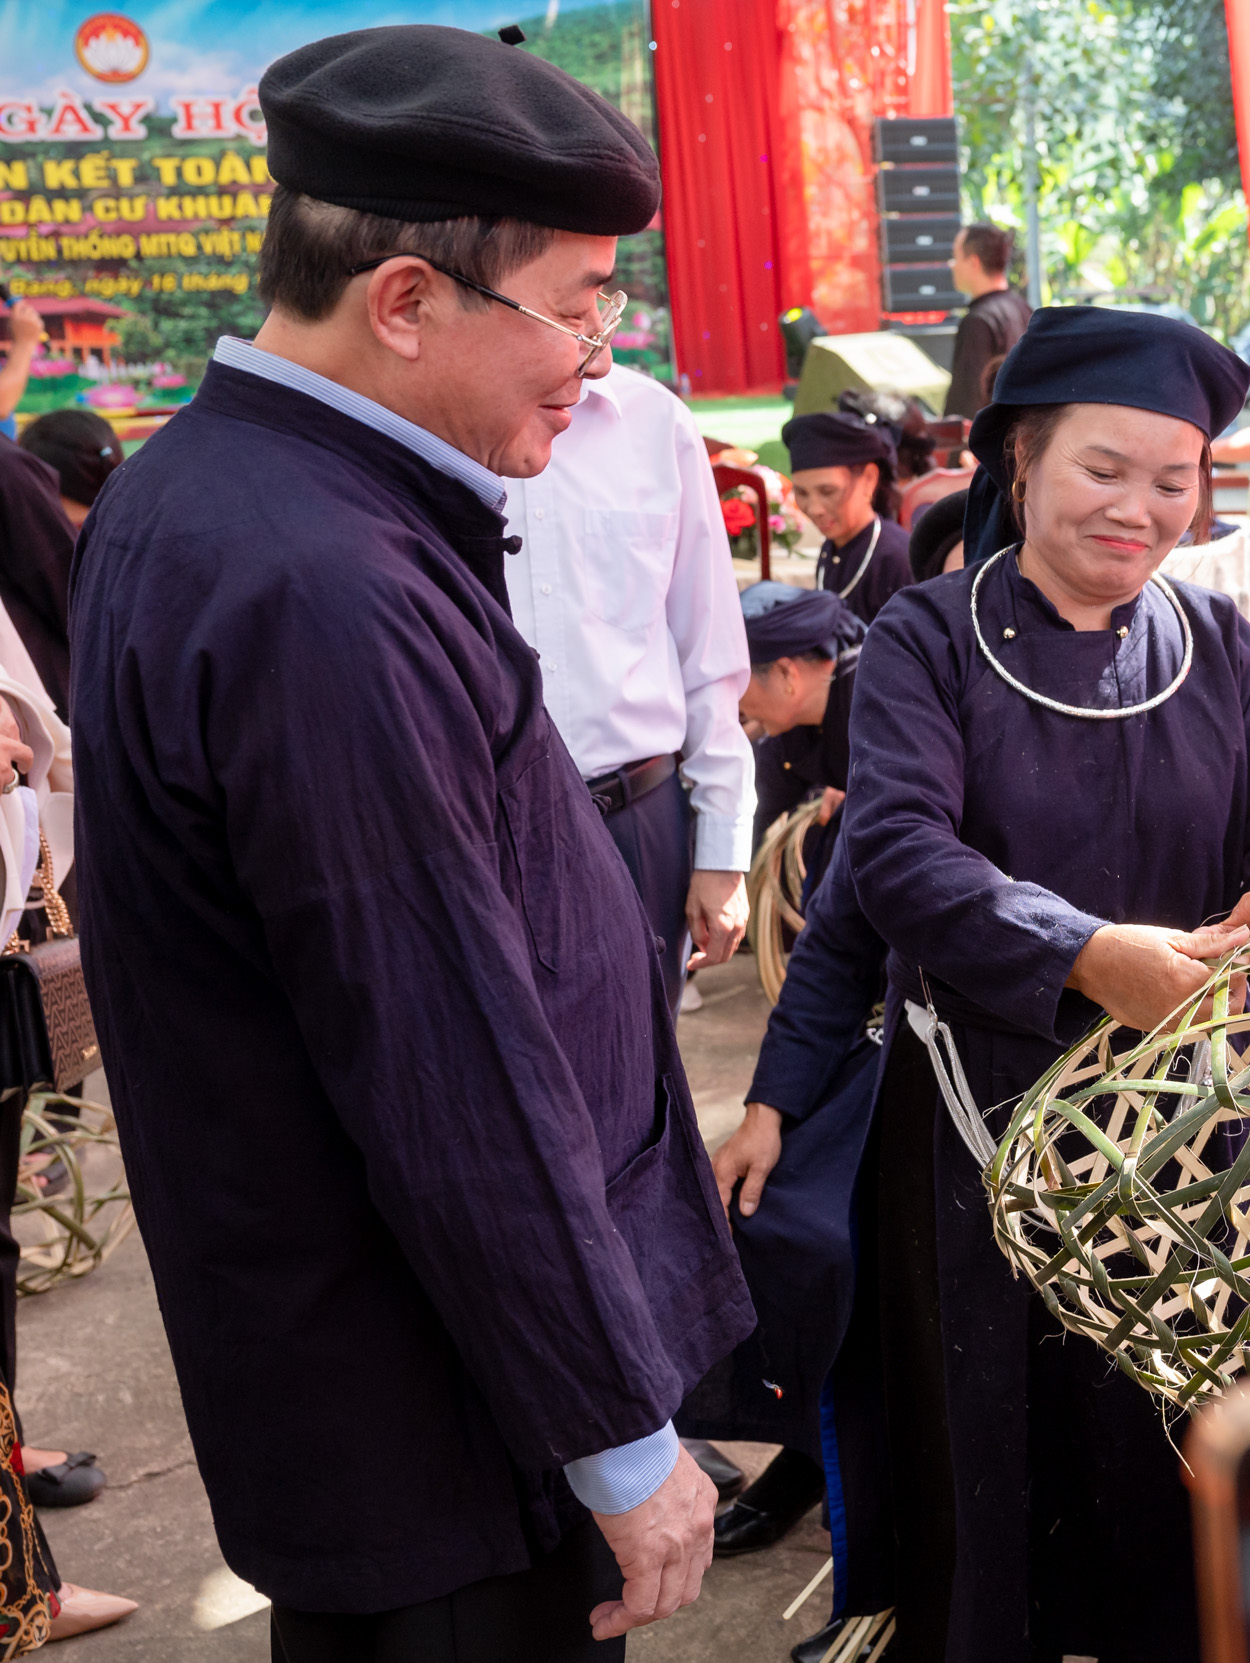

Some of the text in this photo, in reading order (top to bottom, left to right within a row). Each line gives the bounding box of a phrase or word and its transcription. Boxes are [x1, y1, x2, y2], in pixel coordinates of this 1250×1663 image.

[0, 159, 28, 189] N
[43, 150, 138, 189] KẾT
[0, 194, 82, 224] DÂN
[93, 194, 147, 222] CƯ
[60, 227, 136, 259] THỐNG
[199, 226, 242, 262] VIỆT
[182, 270, 249, 294] tháng
